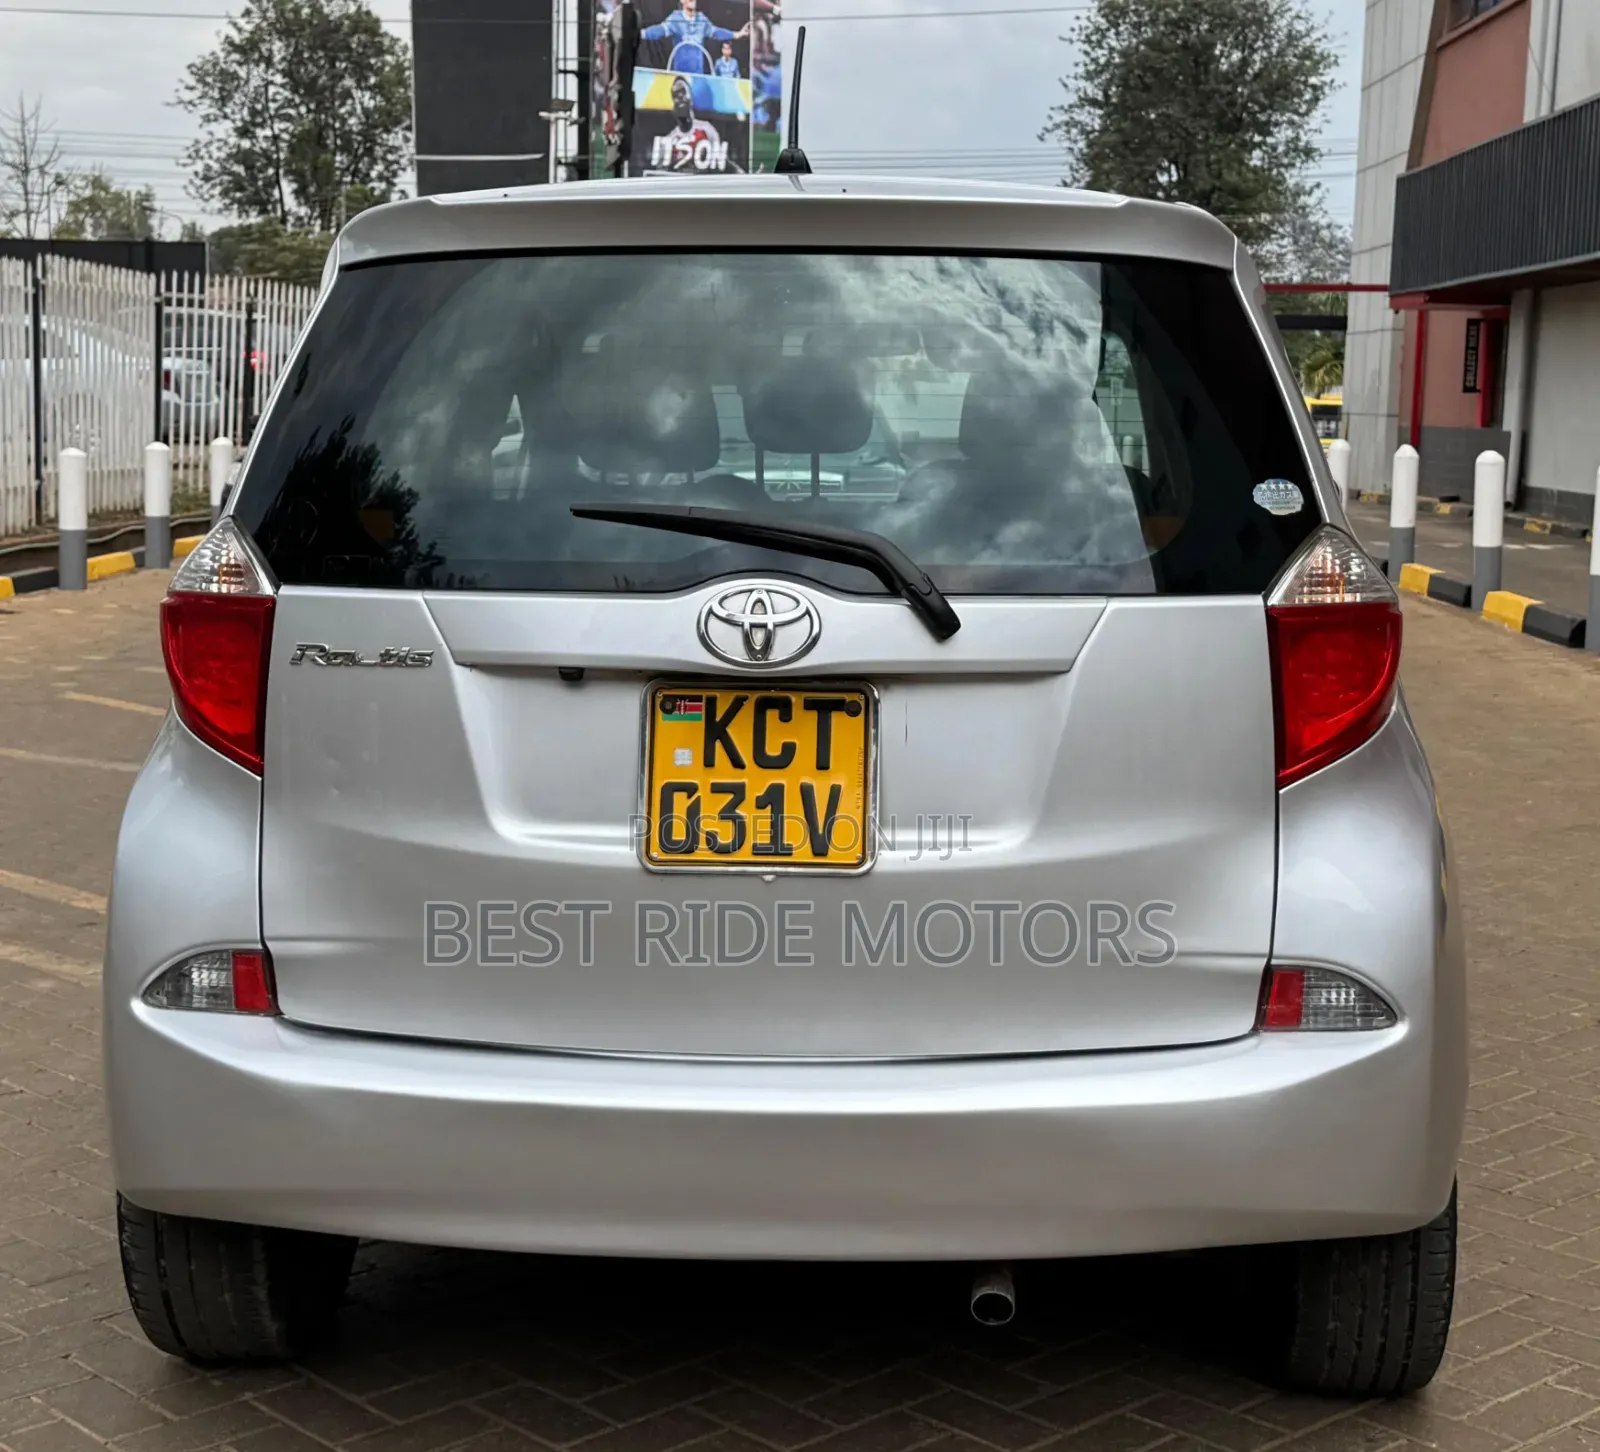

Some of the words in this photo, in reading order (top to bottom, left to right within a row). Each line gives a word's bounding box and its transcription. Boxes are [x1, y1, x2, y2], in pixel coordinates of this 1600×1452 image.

[694, 139, 728, 171] ON
[703, 694, 849, 771] KCT
[658, 781, 843, 857] 031V
